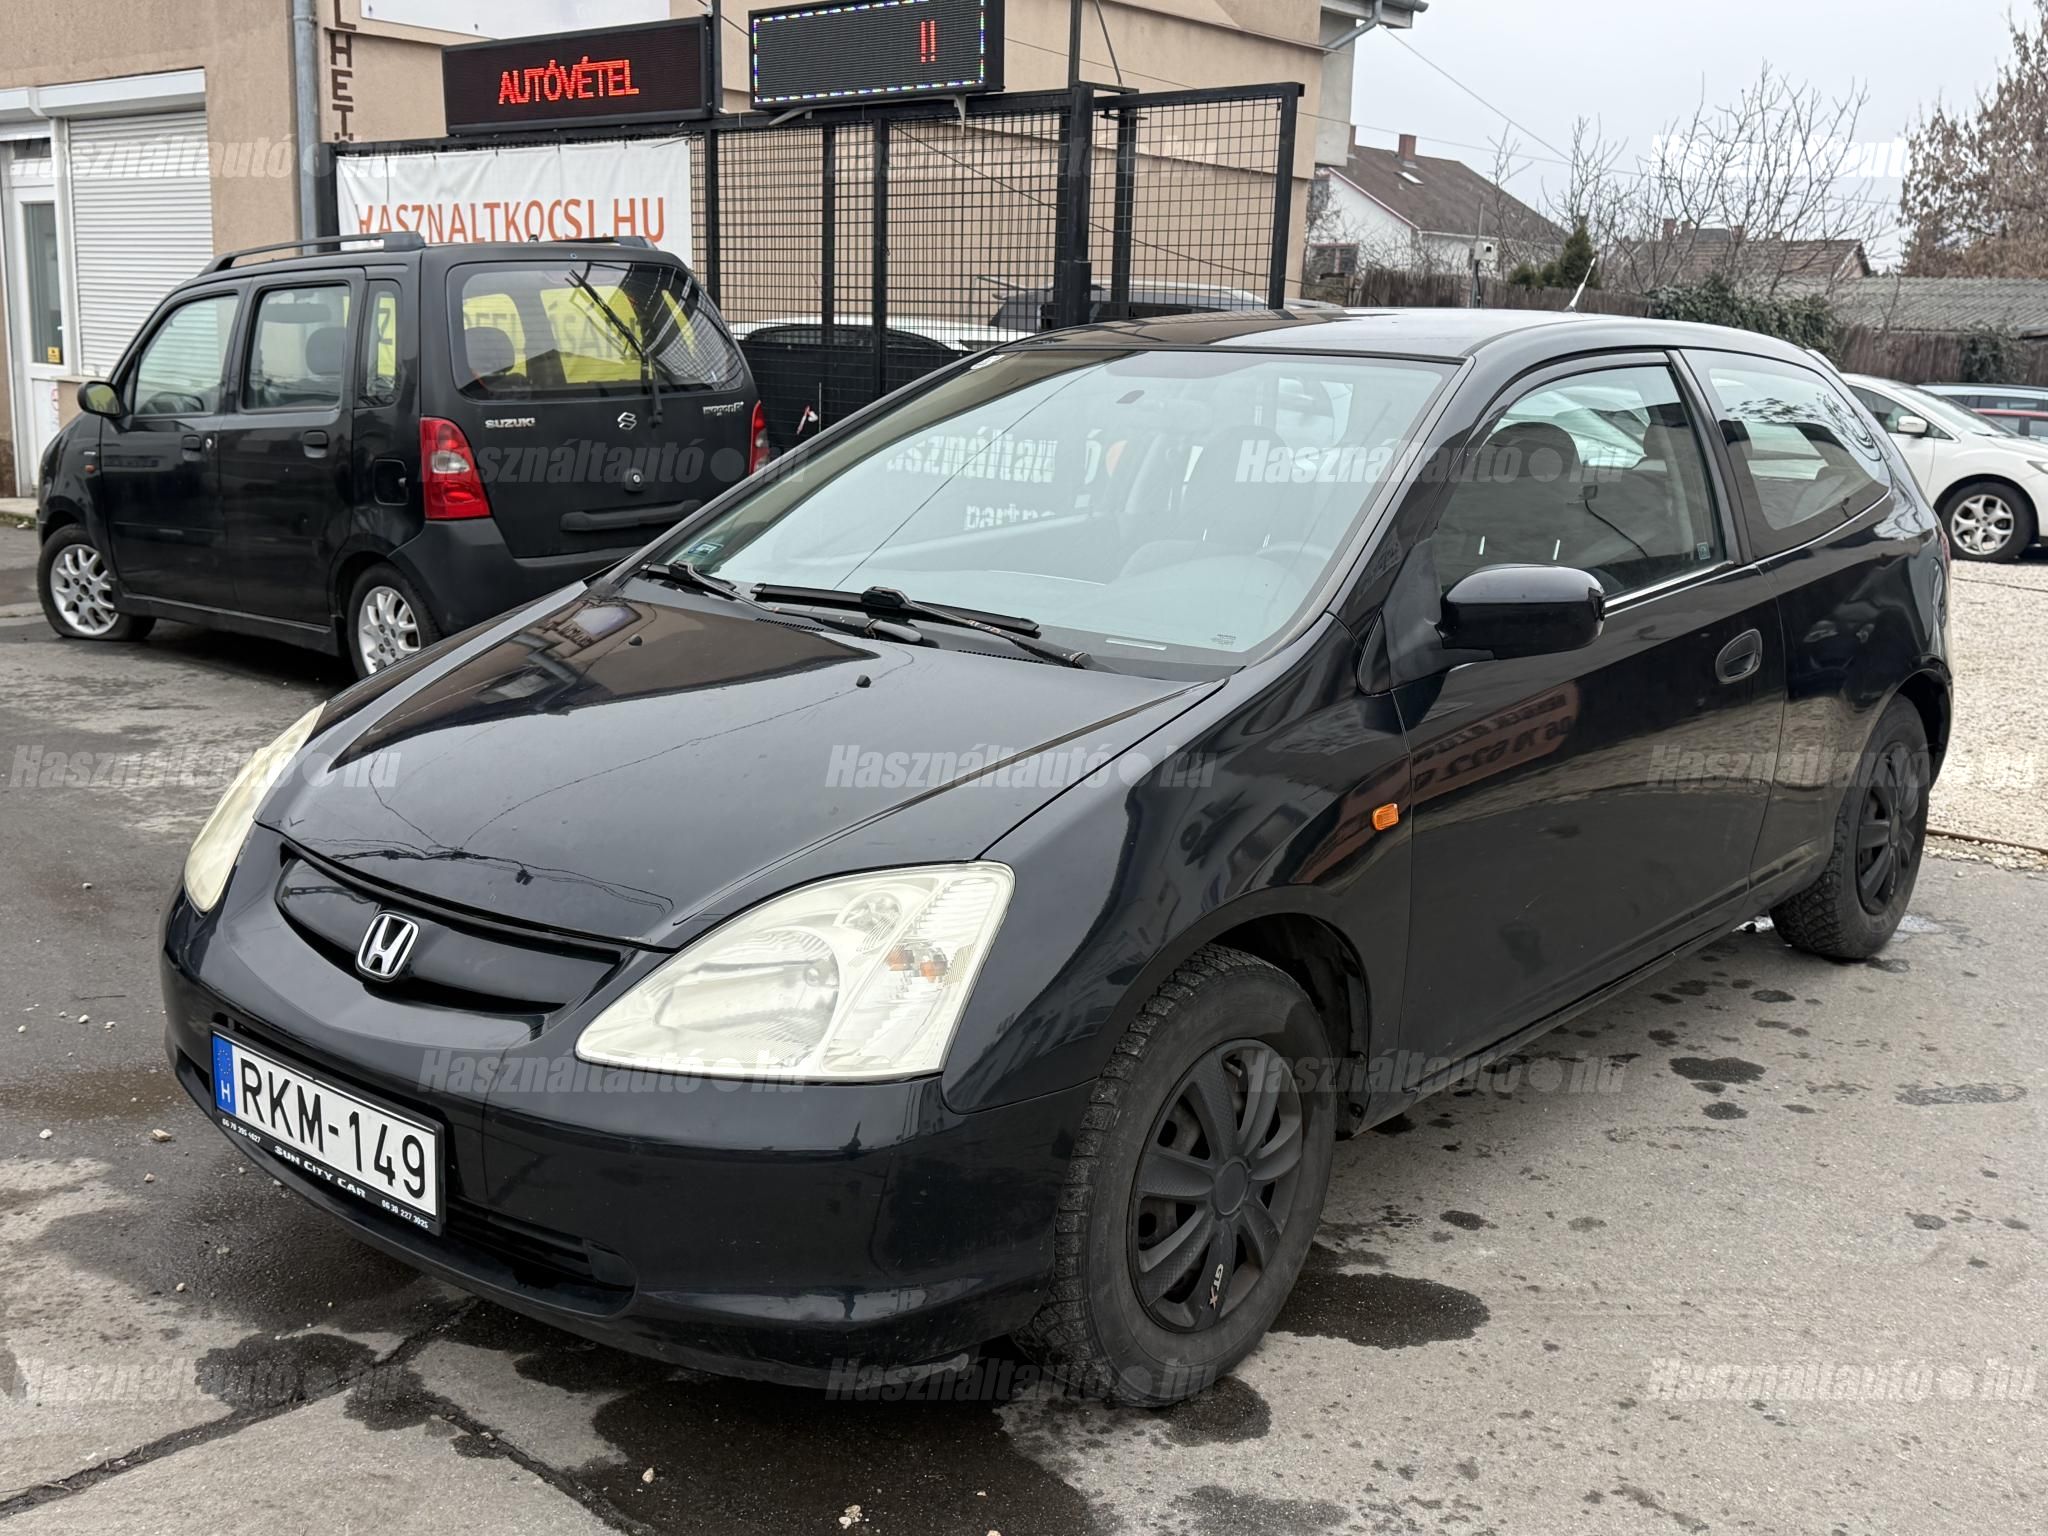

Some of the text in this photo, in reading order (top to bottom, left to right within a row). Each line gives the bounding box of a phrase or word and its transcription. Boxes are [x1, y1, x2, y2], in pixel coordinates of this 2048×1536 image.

[329, 0, 356, 143] LHET
[498, 55, 640, 105] AUTÓVÉTEL
[485, 417, 535, 428] SUZUKI
[240, 1057, 426, 1199] RKM-149
[274, 1145, 366, 1198] SUN CITY CAR
